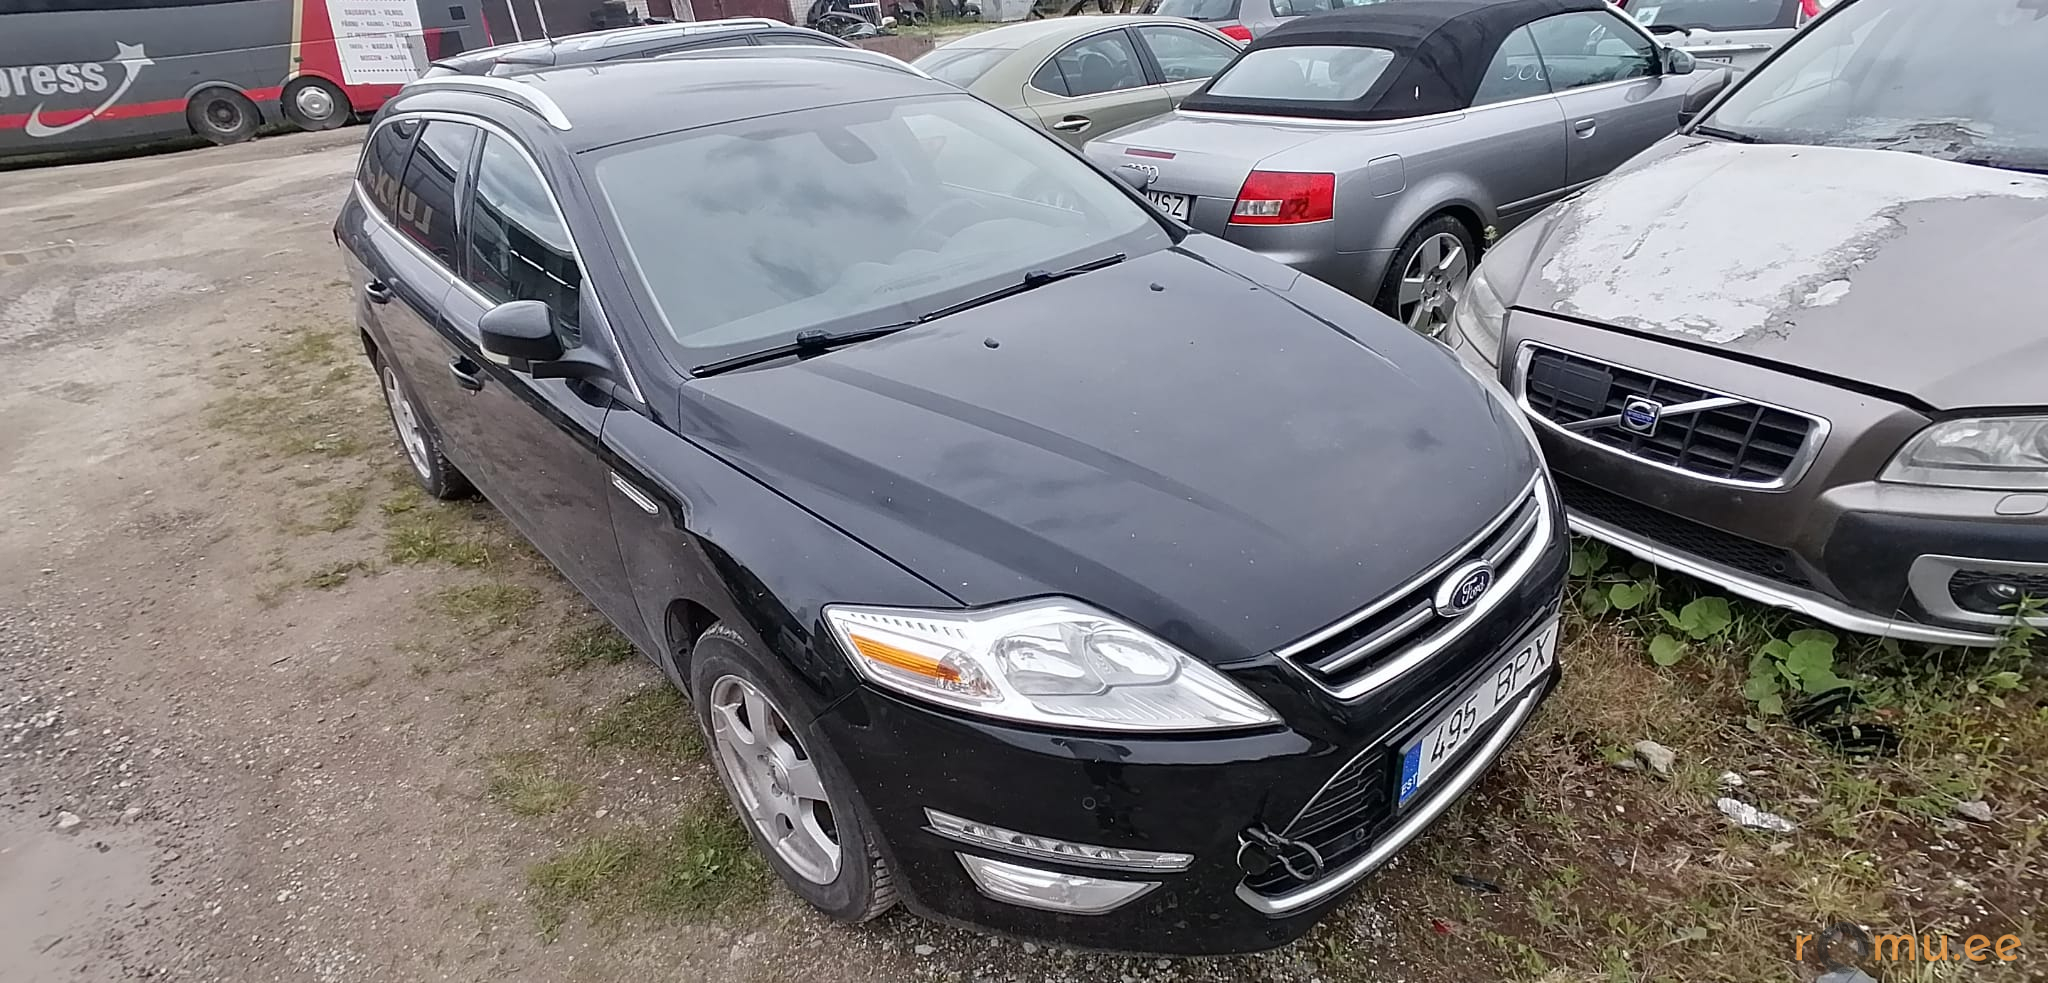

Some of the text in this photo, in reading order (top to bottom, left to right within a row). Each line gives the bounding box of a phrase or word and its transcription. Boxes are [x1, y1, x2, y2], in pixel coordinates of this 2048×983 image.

[1461, 575, 1486, 605] Ford
[1430, 629, 1551, 763] 495 BPX
[1401, 771, 1419, 796] EST
